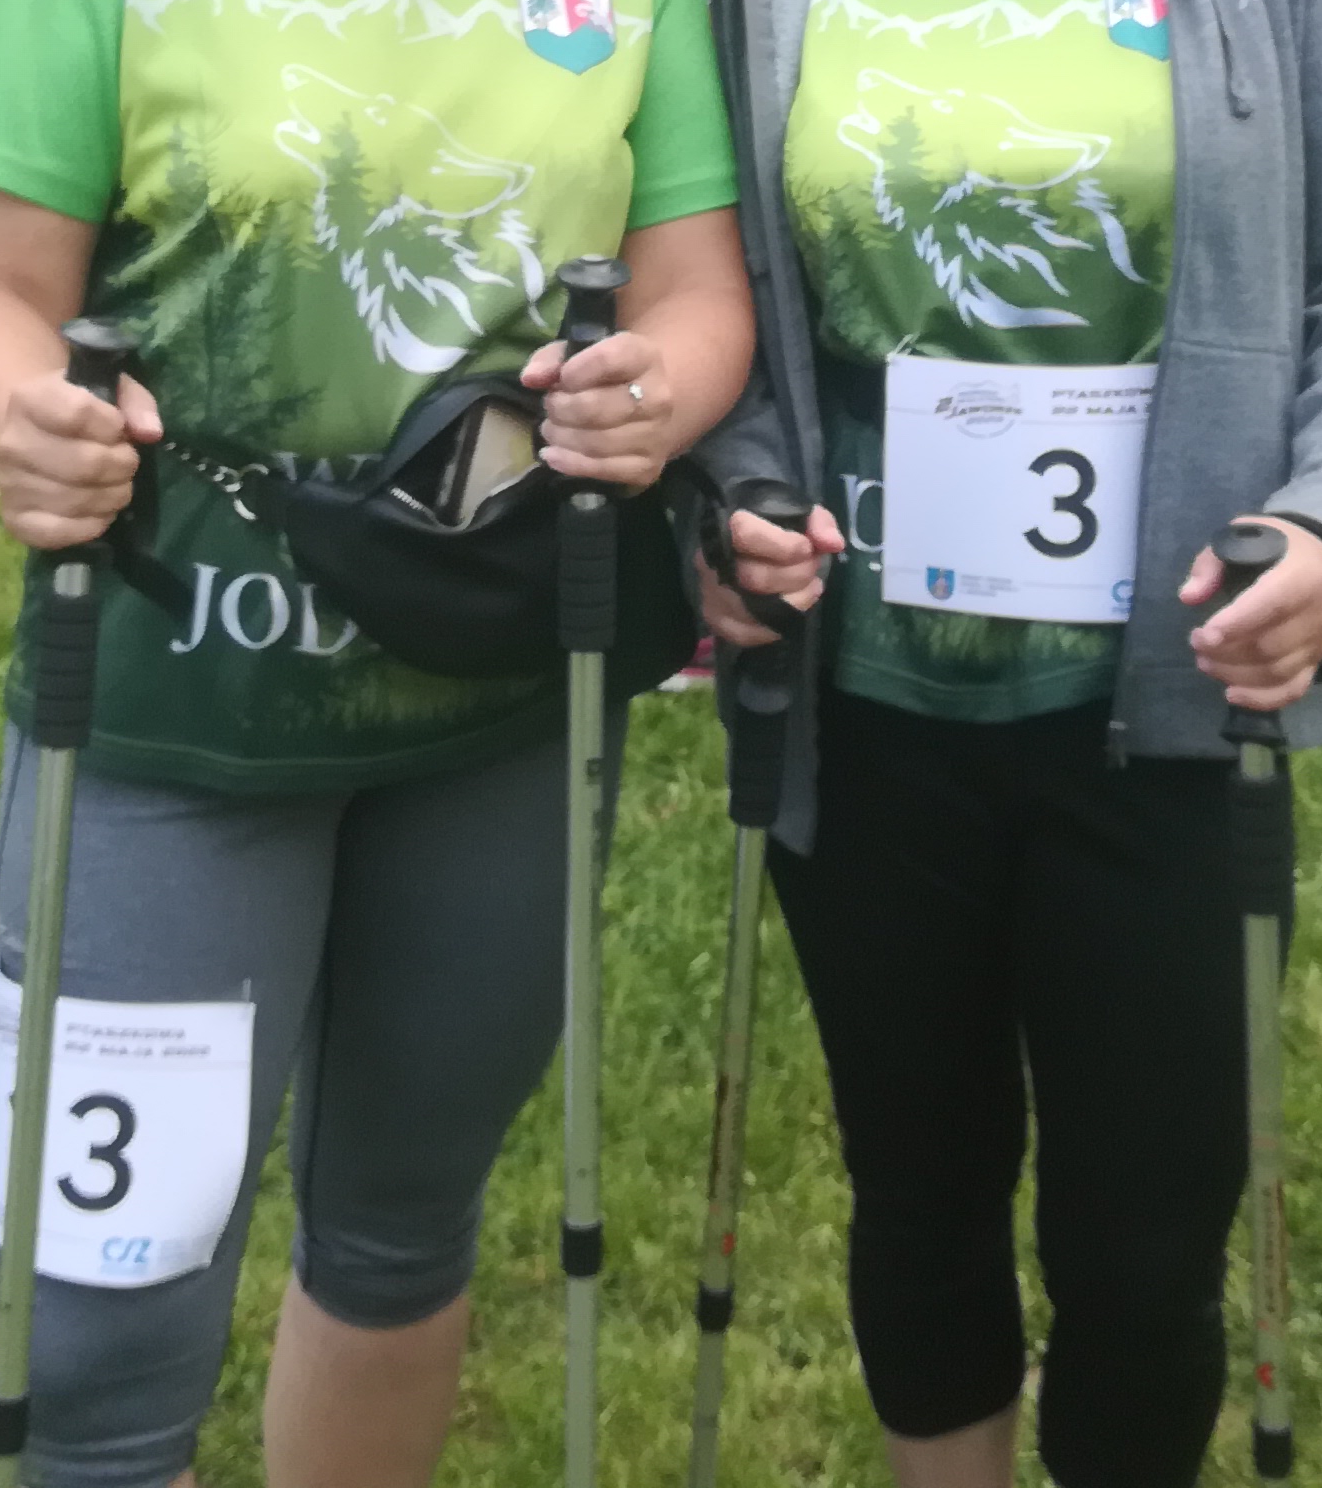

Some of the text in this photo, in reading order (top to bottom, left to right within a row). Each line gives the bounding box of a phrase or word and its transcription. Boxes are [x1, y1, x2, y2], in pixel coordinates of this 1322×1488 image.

[1023, 447, 1099, 558] 3
[169, 562, 361, 656] JOD
[56, 1091, 136, 1211] 3
